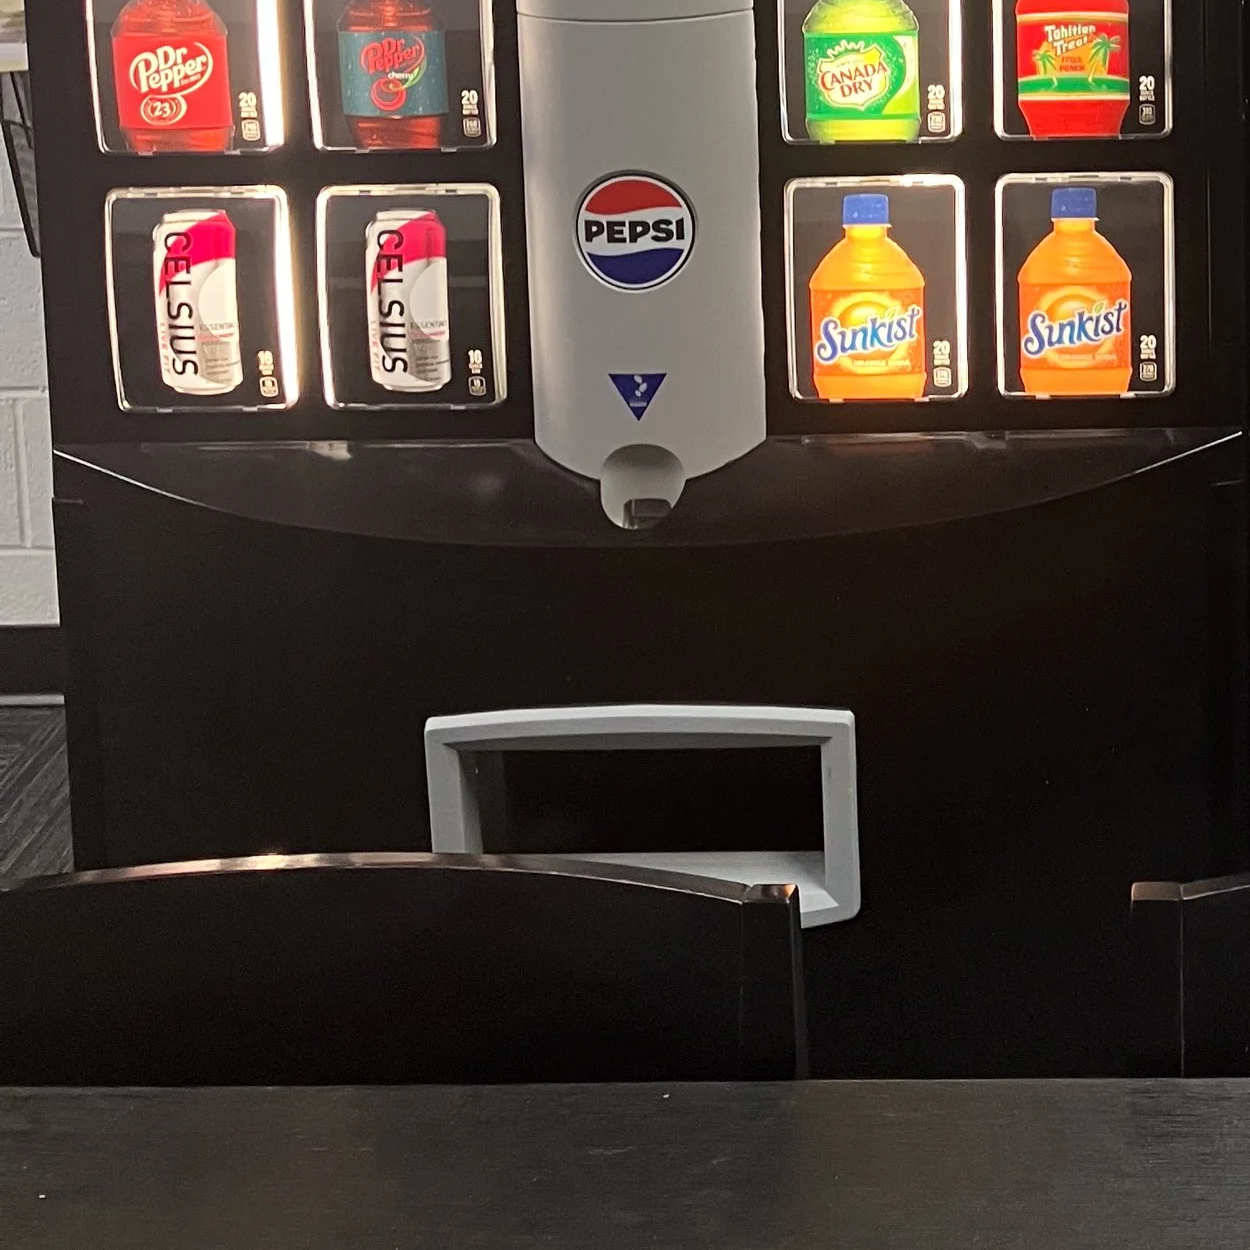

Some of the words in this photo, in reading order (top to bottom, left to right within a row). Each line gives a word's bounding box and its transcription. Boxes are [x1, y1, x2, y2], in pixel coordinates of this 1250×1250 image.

[1044, 24, 1096, 43] Tahitian
[160, 45, 188, 65] Dr
[385, 36, 405, 55] Dr
[1053, 35, 1088, 56] Treat
[366, 43, 421, 73] Pepper
[133, 54, 207, 93] Pepper
[820, 61, 888, 91] CANADA
[1139, 75, 1155, 91] 20
[461, 89, 479, 105] 20
[839, 79, 875, 98] DRY
[927, 84, 945, 99] 20
[152, 100, 171, 116] 23
[238, 91, 257, 107] 20
[584, 217, 686, 244] PEPSI
[164, 231, 199, 376] CELSIUS
[376, 228, 409, 375] CELSIUS
[817, 306, 921, 363] Sunkist
[1024, 300, 1127, 358] Sunkist
[933, 340, 951, 354] 20
[1140, 334, 1157, 350] 20
